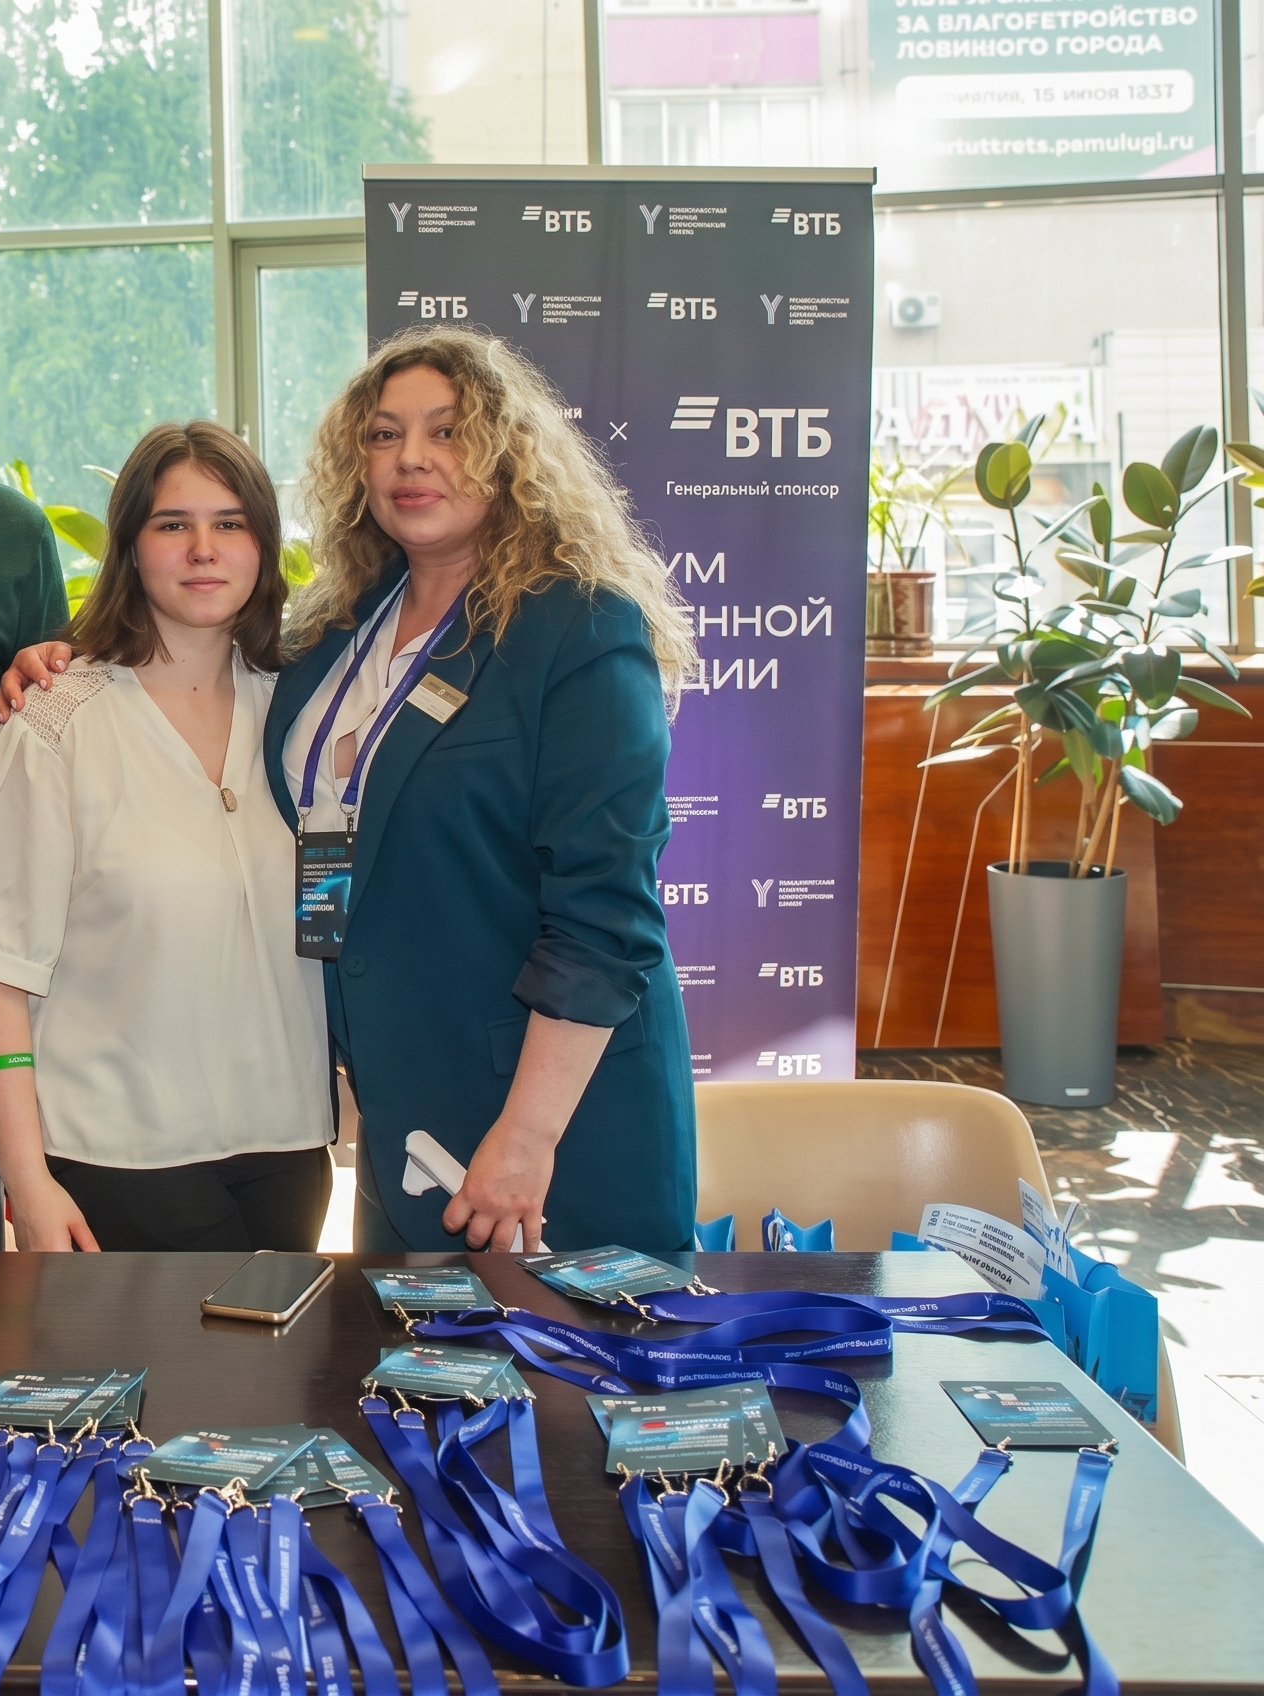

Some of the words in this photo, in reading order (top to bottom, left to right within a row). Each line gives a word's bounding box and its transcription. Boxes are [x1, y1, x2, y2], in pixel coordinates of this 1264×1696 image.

[896, 15, 930, 34] ЗА
[1055, 34, 1164, 56] ГОРОДА
[544, 210, 593, 233] ВТБ
[793, 213, 842, 236] ВТБ
[420, 296, 469, 319] ВТБ
[670, 297, 718, 320] ВТБ
[726, 408, 833, 458] ВТБ
[666, 480, 770, 499] Генеральный
[774, 484, 840, 499] спонсор
[782, 797, 828, 819] ВТБ
[664, 883, 709, 905] ВТБ
[779, 965, 823, 987] ВТБ
[777, 1053, 822, 1076] ВТБ
